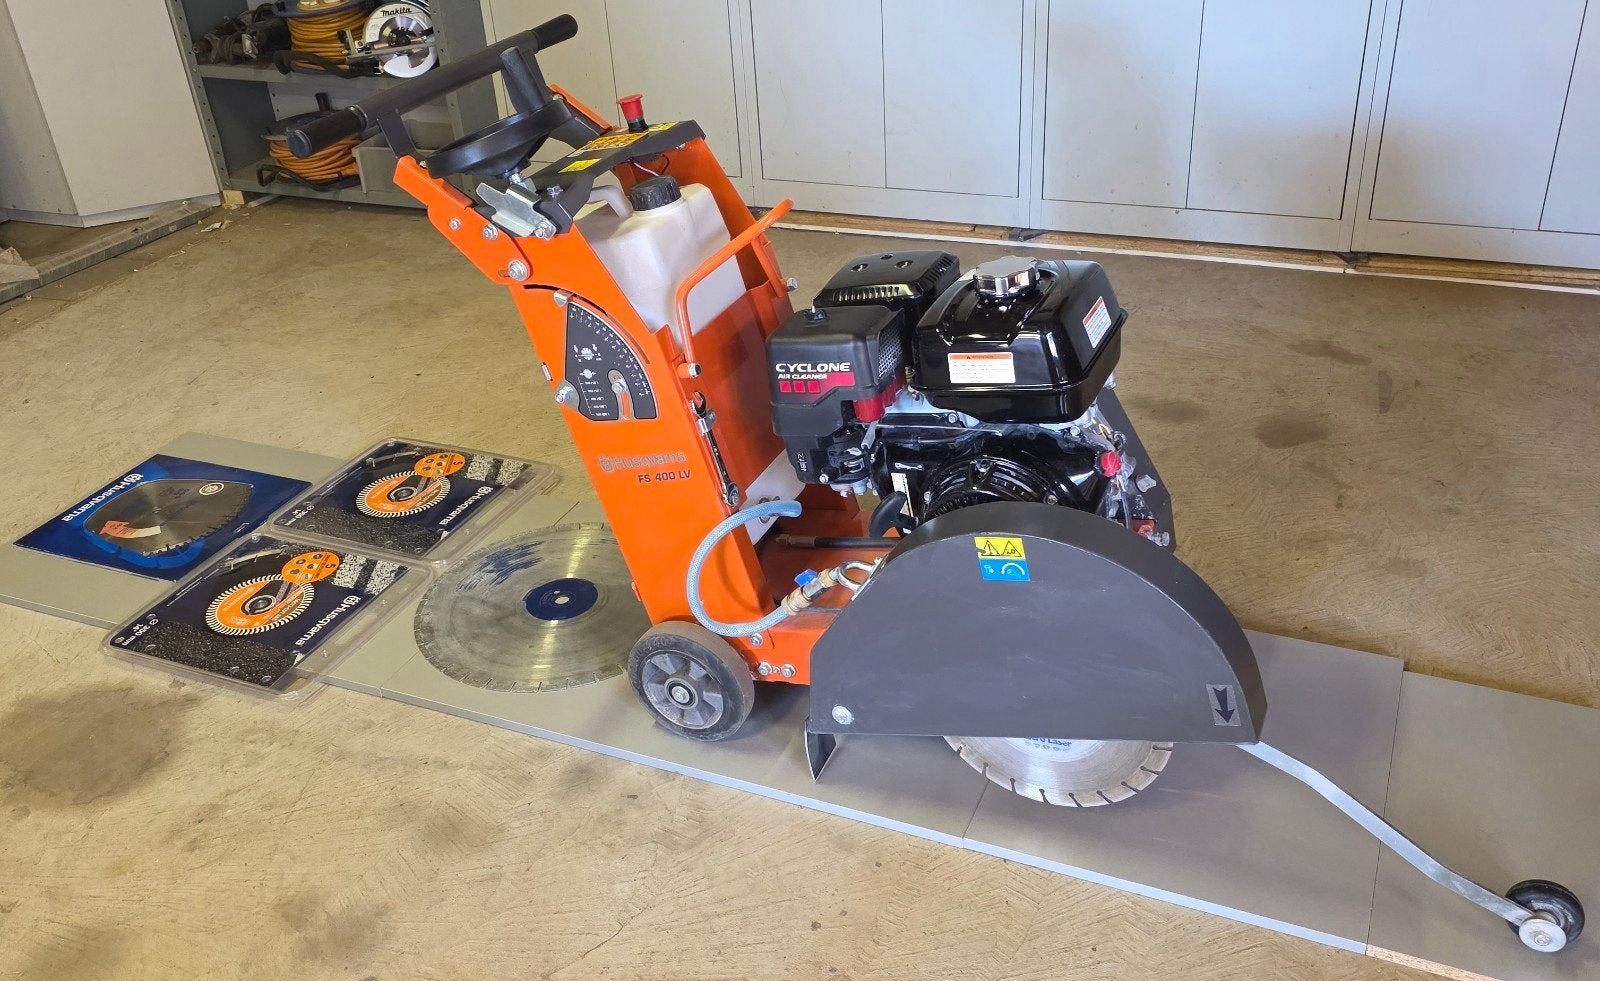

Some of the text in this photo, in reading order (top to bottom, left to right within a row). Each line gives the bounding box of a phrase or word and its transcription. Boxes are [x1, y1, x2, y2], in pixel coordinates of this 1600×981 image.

[776, 362, 850, 372] CYCLONE
[614, 452, 687, 468] Husqvarna
[638, 470, 690, 483] FS 400 LV
[61, 481, 130, 522] Husqvarna
[439, 492, 484, 525] Husqvarna
[294, 604, 350, 646] Husqvarna
